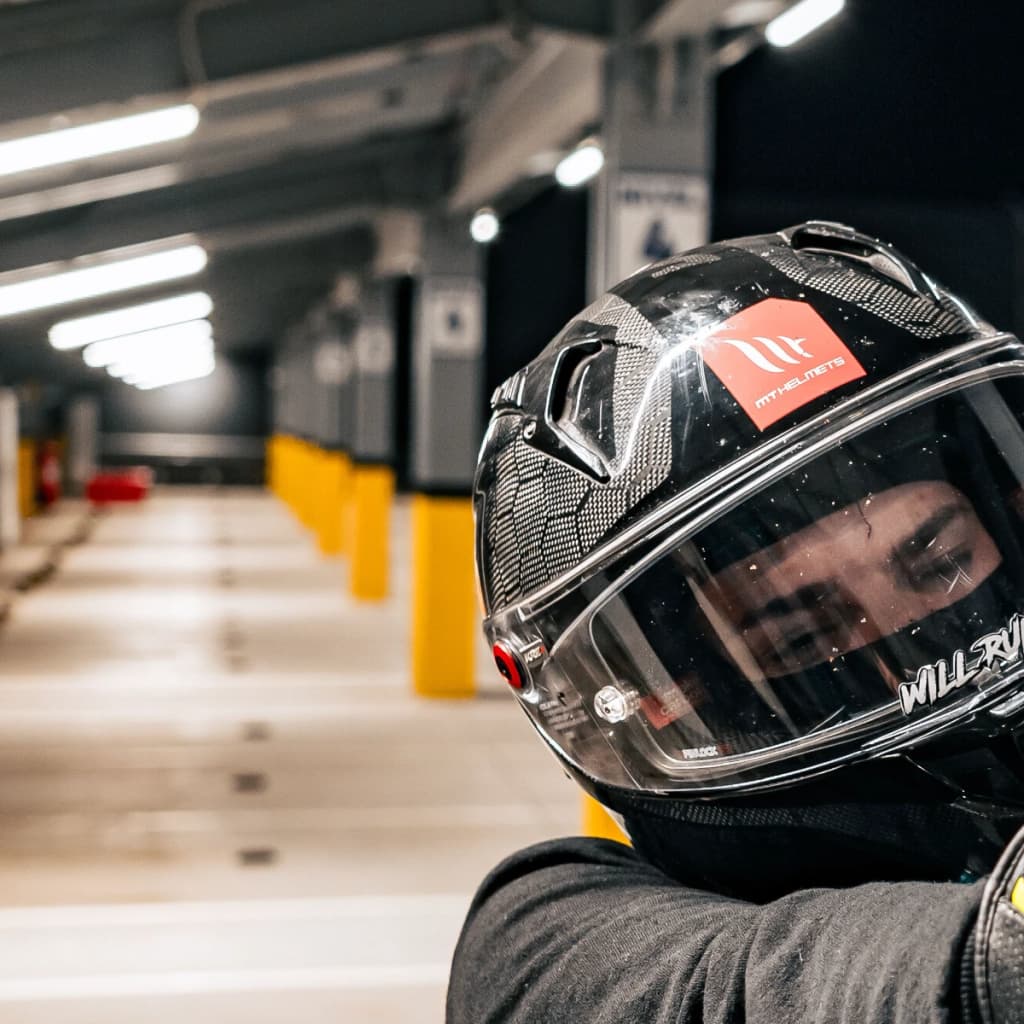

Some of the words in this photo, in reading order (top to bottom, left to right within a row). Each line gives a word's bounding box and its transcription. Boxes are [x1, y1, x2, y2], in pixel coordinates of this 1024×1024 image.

[754, 389, 777, 409] MT
[777, 356, 846, 395] HELMETS
[899, 649, 982, 716] WILL
